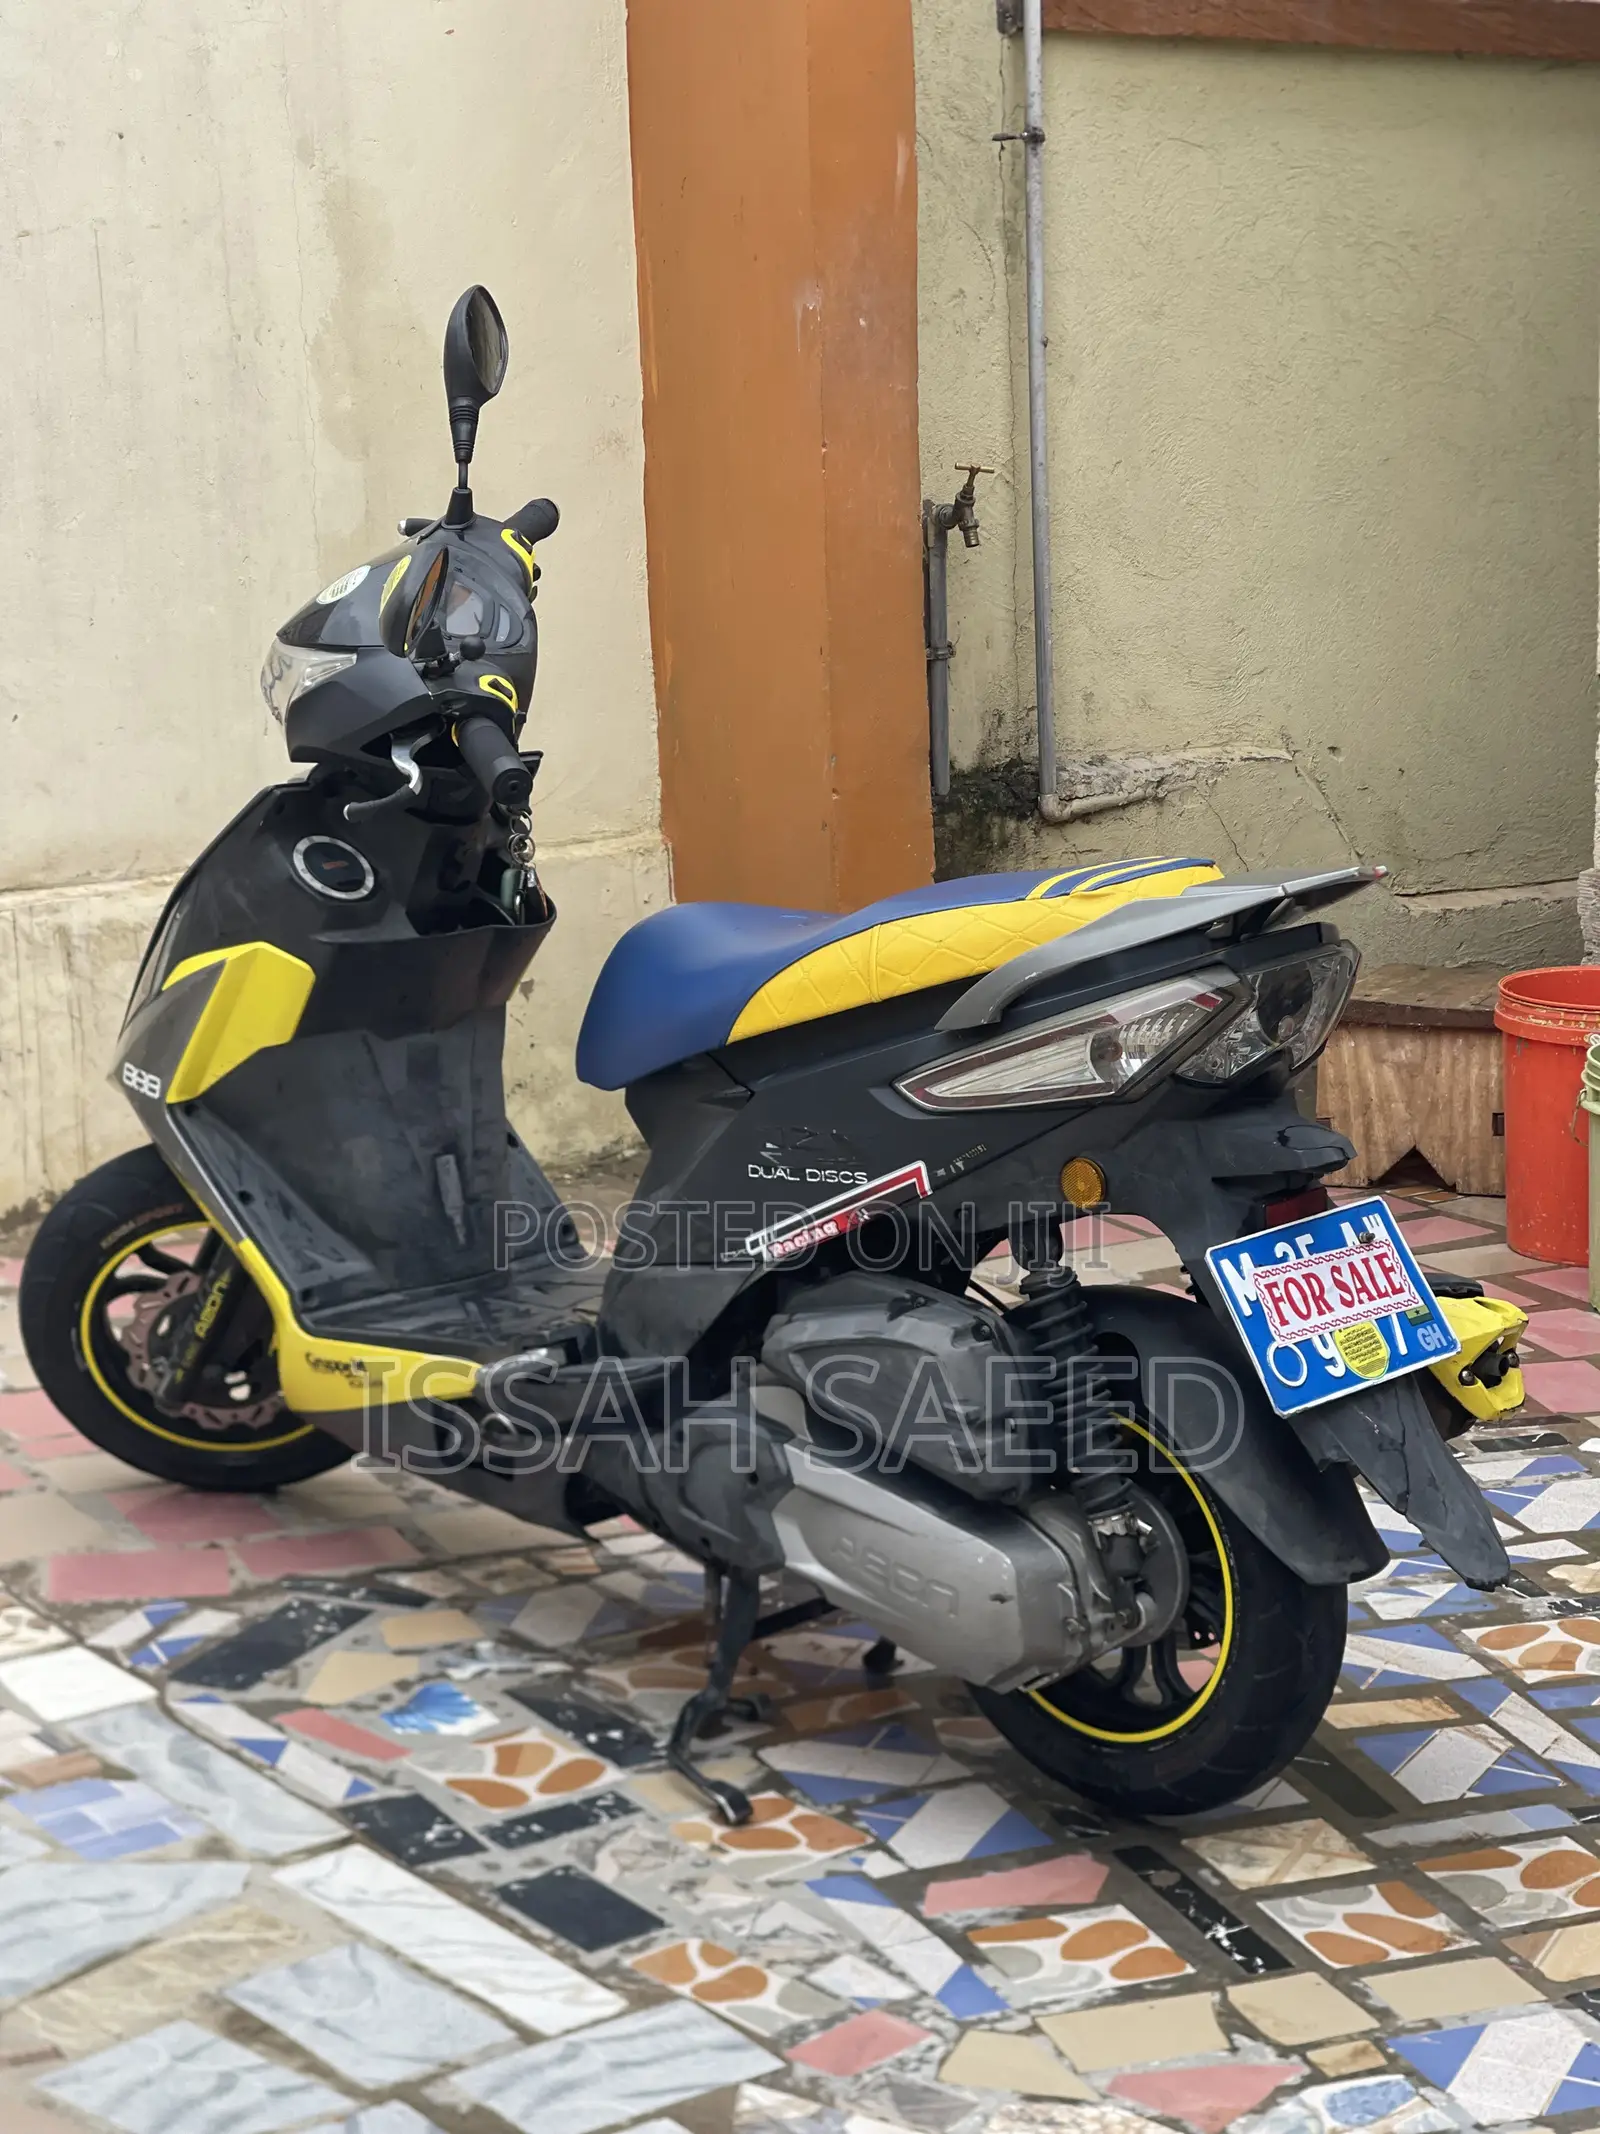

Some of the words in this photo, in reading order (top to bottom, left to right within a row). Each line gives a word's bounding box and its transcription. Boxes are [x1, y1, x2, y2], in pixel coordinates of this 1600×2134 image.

[748, 1164, 800, 1181] DUAL
[805, 1168, 868, 1185] DISCS
[767, 1219, 842, 1260] Racing
[1264, 1272, 1334, 1328] FOR
[1330, 1252, 1407, 1309] SALE
[1416, 1323, 1447, 1352] GH
